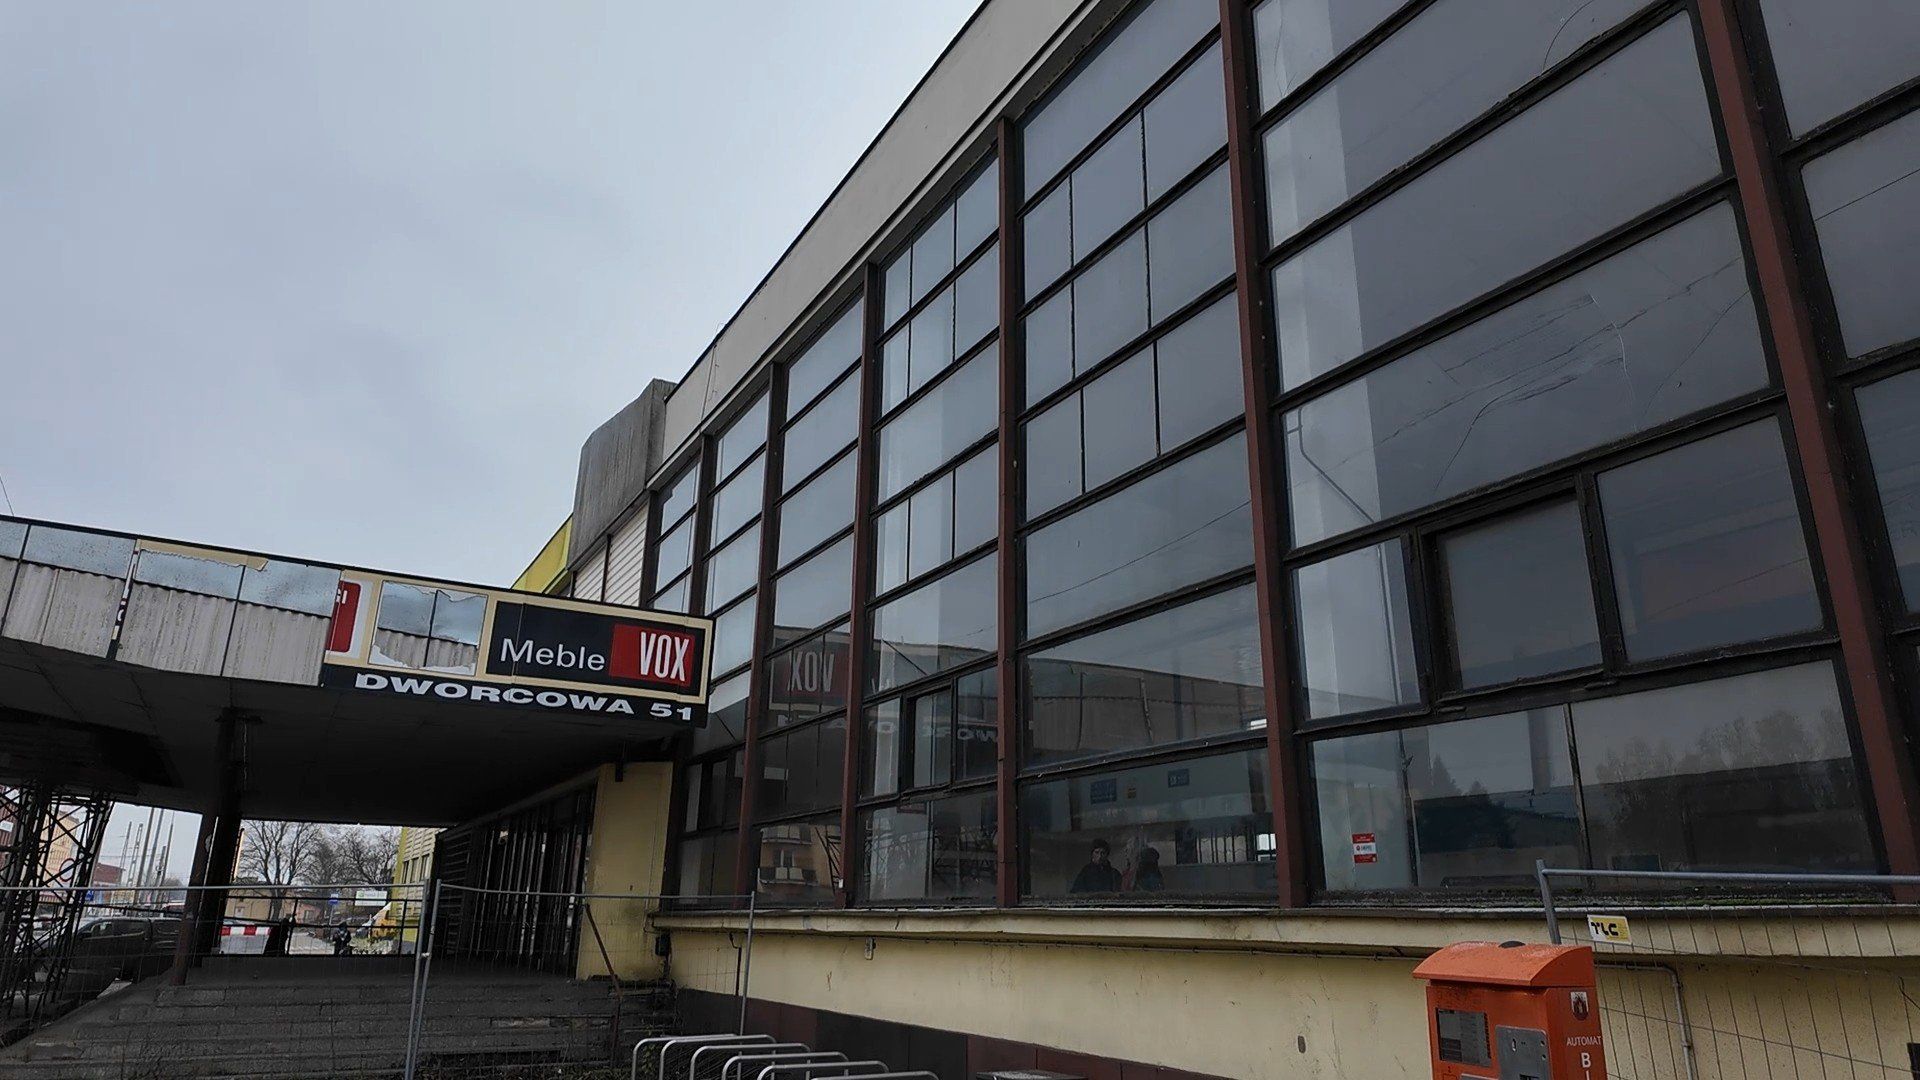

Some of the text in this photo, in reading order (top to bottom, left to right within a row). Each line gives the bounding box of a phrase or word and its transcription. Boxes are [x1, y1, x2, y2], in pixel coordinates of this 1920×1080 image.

[501, 631, 690, 682] Meble VOX
[354, 672, 692, 721] DWORCOWA 51
[1590, 921, 1619, 936] TLC
[1566, 1035, 1602, 1046] AUTOMAT
